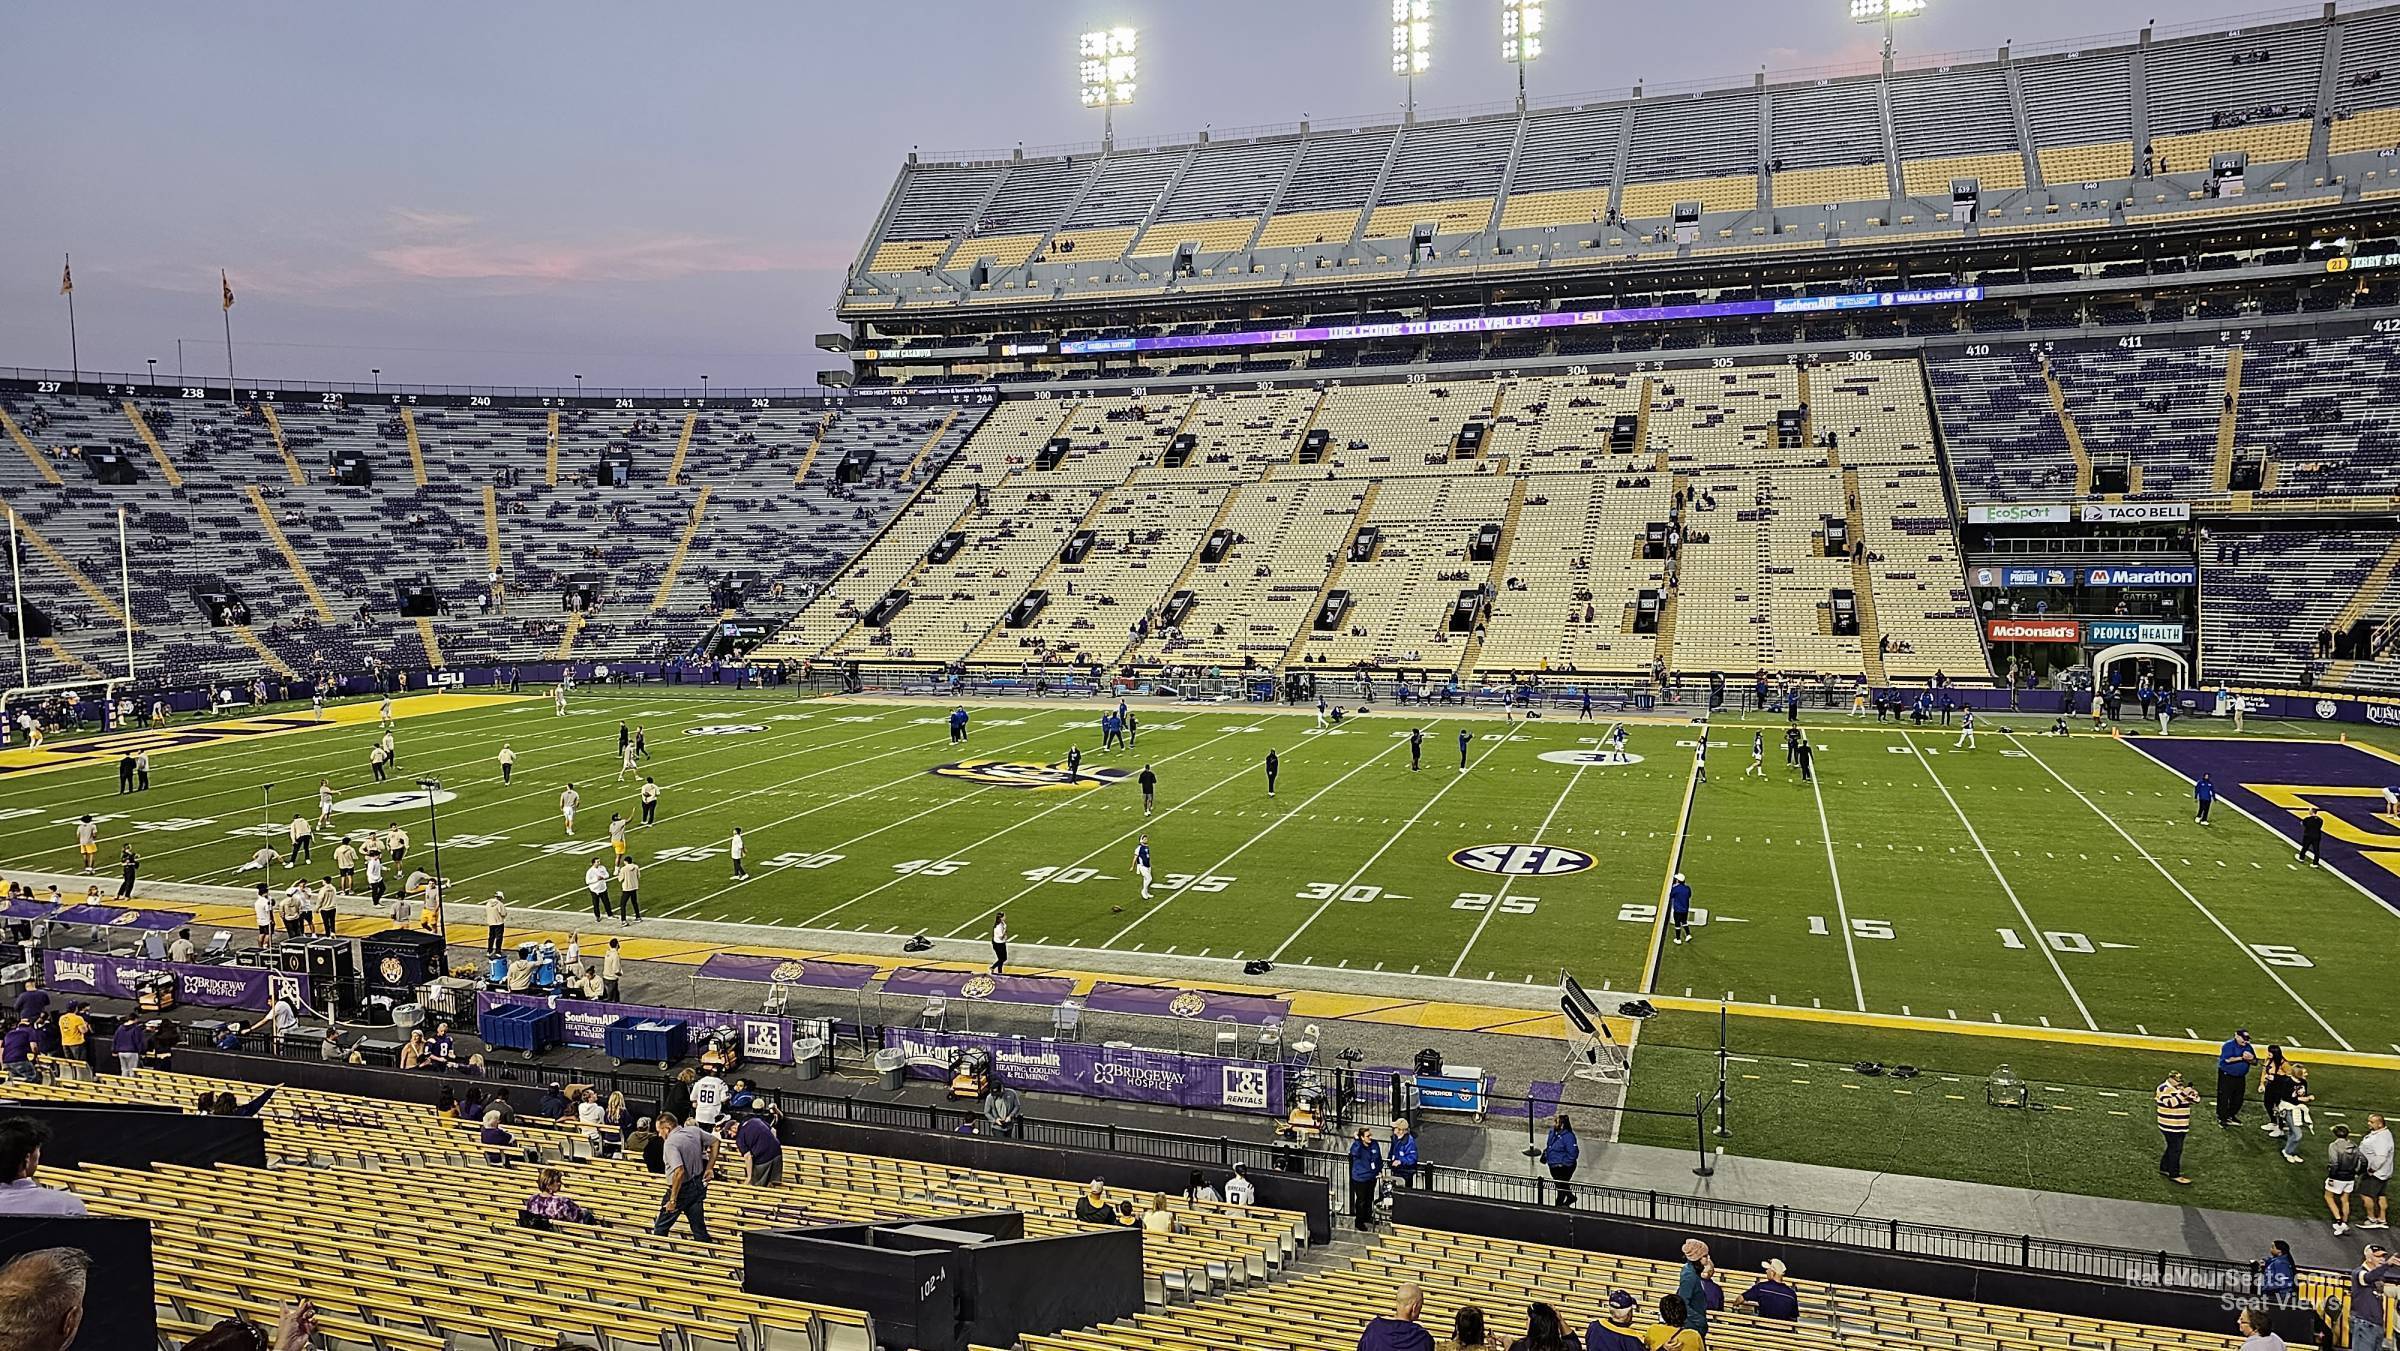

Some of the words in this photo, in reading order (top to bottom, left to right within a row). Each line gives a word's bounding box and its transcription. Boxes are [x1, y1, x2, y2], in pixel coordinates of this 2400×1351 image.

[2350, 255, 2382, 270] JERRY
[1897, 291, 1963, 303] WALK-ON'S
[1774, 296, 1836, 313] SouthernAIR
[1573, 312, 1603, 324] LSU
[1328, 322, 1401, 340] WELCOME
[1407, 321, 1426, 334] TO
[1429, 318, 1481, 333] DEATH
[1484, 314, 1543, 330] VALLEY
[2373, 319, 2400, 332] 412
[2119, 336, 2143, 348] 411
[1848, 351, 1872, 361] 306
[1966, 344, 1990, 356] 410
[1711, 358, 1734, 368] 305
[1567, 365, 1588, 376] 304
[1407, 374, 1427, 384] 303
[38, 382, 61, 393] 237
[1131, 387, 1148, 396] 301
[1256, 381, 1274, 391] 302
[181, 388, 205, 399] 238
[977, 395, 993, 404] 244
[1034, 391, 1051, 400] 300
[470, 397, 491, 407] 240
[615, 399, 634, 408] 241
[752, 399, 770, 408] 242
[891, 397, 908, 406] 243
[1987, 506, 2050, 522] EcoSport
[2109, 507, 2146, 518] TACO
[2149, 506, 2185, 518] BELL
[2009, 573, 2038, 583] PROTEIN
[2112, 570, 2193, 584] Marathon
[2122, 593, 2147, 601] GATE
[2148, 593, 2158, 601] 12
[1992, 626, 2075, 638] McDonald's
[2093, 626, 2138, 640] PEOPLES
[2142, 628, 2180, 640] HEALTH
[427, 672, 465, 686] LSU
[1481, 734, 1532, 742] 30
[1887, 746, 1940, 755] 10
[1999, 750, 2029, 758] 5
[653, 846, 727, 862] 45
[1460, 845, 1585, 874] SEC
[760, 852, 846, 869] 50
[892, 859, 971, 876] 45
[1021, 866, 1099, 884] 40
[1151, 873, 1237, 893] 35
[1295, 882, 1383, 903] 30
[1450, 892, 1541, 914] 25
[1617, 903, 1709, 926] 20
[1807, 916, 1896, 940] 15
[1995, 928, 2096, 953] 10
[2249, 943, 2316, 968] 5
[198, 977, 246, 992] BRIDGEWAY
[206, 987, 238, 997] HOSPICE
[581, 1030, 605, 1039] PLUMBIN
[747, 1024, 778, 1047] H&E
[440, 1042, 449, 1057] 8
[747, 1047, 777, 1056] RENTALS
[995, 1049, 1061, 1067] SouthernAIR
[995, 1063, 1028, 1074] HEATING,
[1028, 1067, 1061, 1076] COOLING
[1114, 1064, 1186, 1085] BRIDGEWAY
[1014, 1072, 1049, 1081] PLUMBING
[1127, 1077, 1173, 1091] HOSPICE
[1226, 1070, 1265, 1096] H&E
[700, 1089, 715, 1104] 88
[1226, 1095, 1263, 1105] RENTALS
[920, 1265, 947, 1302] 102-A
